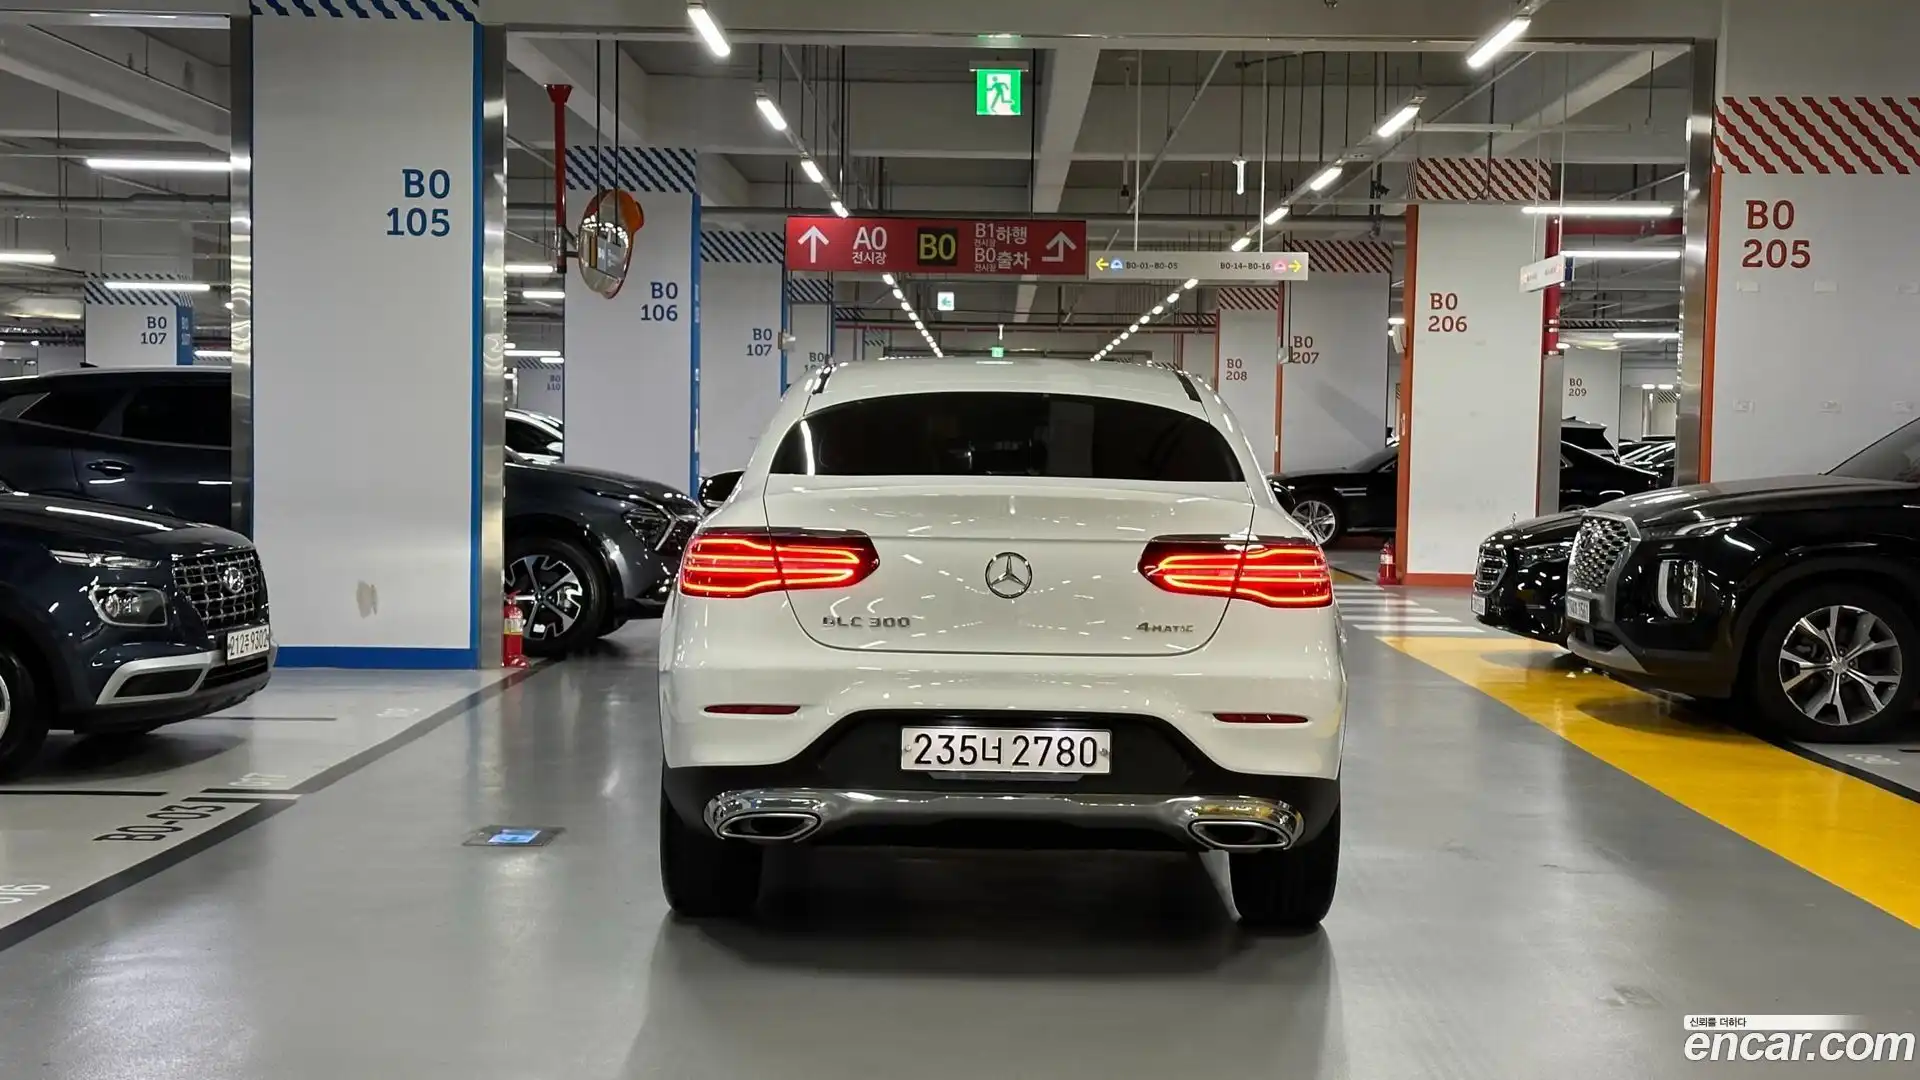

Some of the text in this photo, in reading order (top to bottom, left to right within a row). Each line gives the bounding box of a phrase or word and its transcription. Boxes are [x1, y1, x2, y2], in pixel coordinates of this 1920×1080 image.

[402, 168, 451, 199] B0
[386, 207, 451, 237] 105
[1745, 199, 1795, 230] B0
[853, 226, 887, 250] A0
[975, 223, 1027, 245] B1 하행
[919, 233, 956, 260] B0
[1742, 239, 1811, 268] 205
[852, 251, 888, 265] 전시장
[974, 247, 1031, 270] B0 출차
[651, 282, 678, 299] B0
[1430, 292, 1458, 310] B0
[640, 304, 679, 321] 106
[147, 316, 167, 329] B0
[1428, 315, 1468, 332] 206
[140, 332, 167, 345] 107
[753, 328, 772, 341] B0
[1293, 336, 1313, 348] B0
[747, 344, 772, 356] 107
[1292, 352, 1319, 364] 207
[1226, 358, 1242, 369] B0
[1226, 371, 1248, 381] 208
[1569, 377, 1582, 387] B0
[1568, 388, 1587, 397] 209
[869, 616, 911, 628] 300
[913, 733, 1098, 767] 235너 2780
